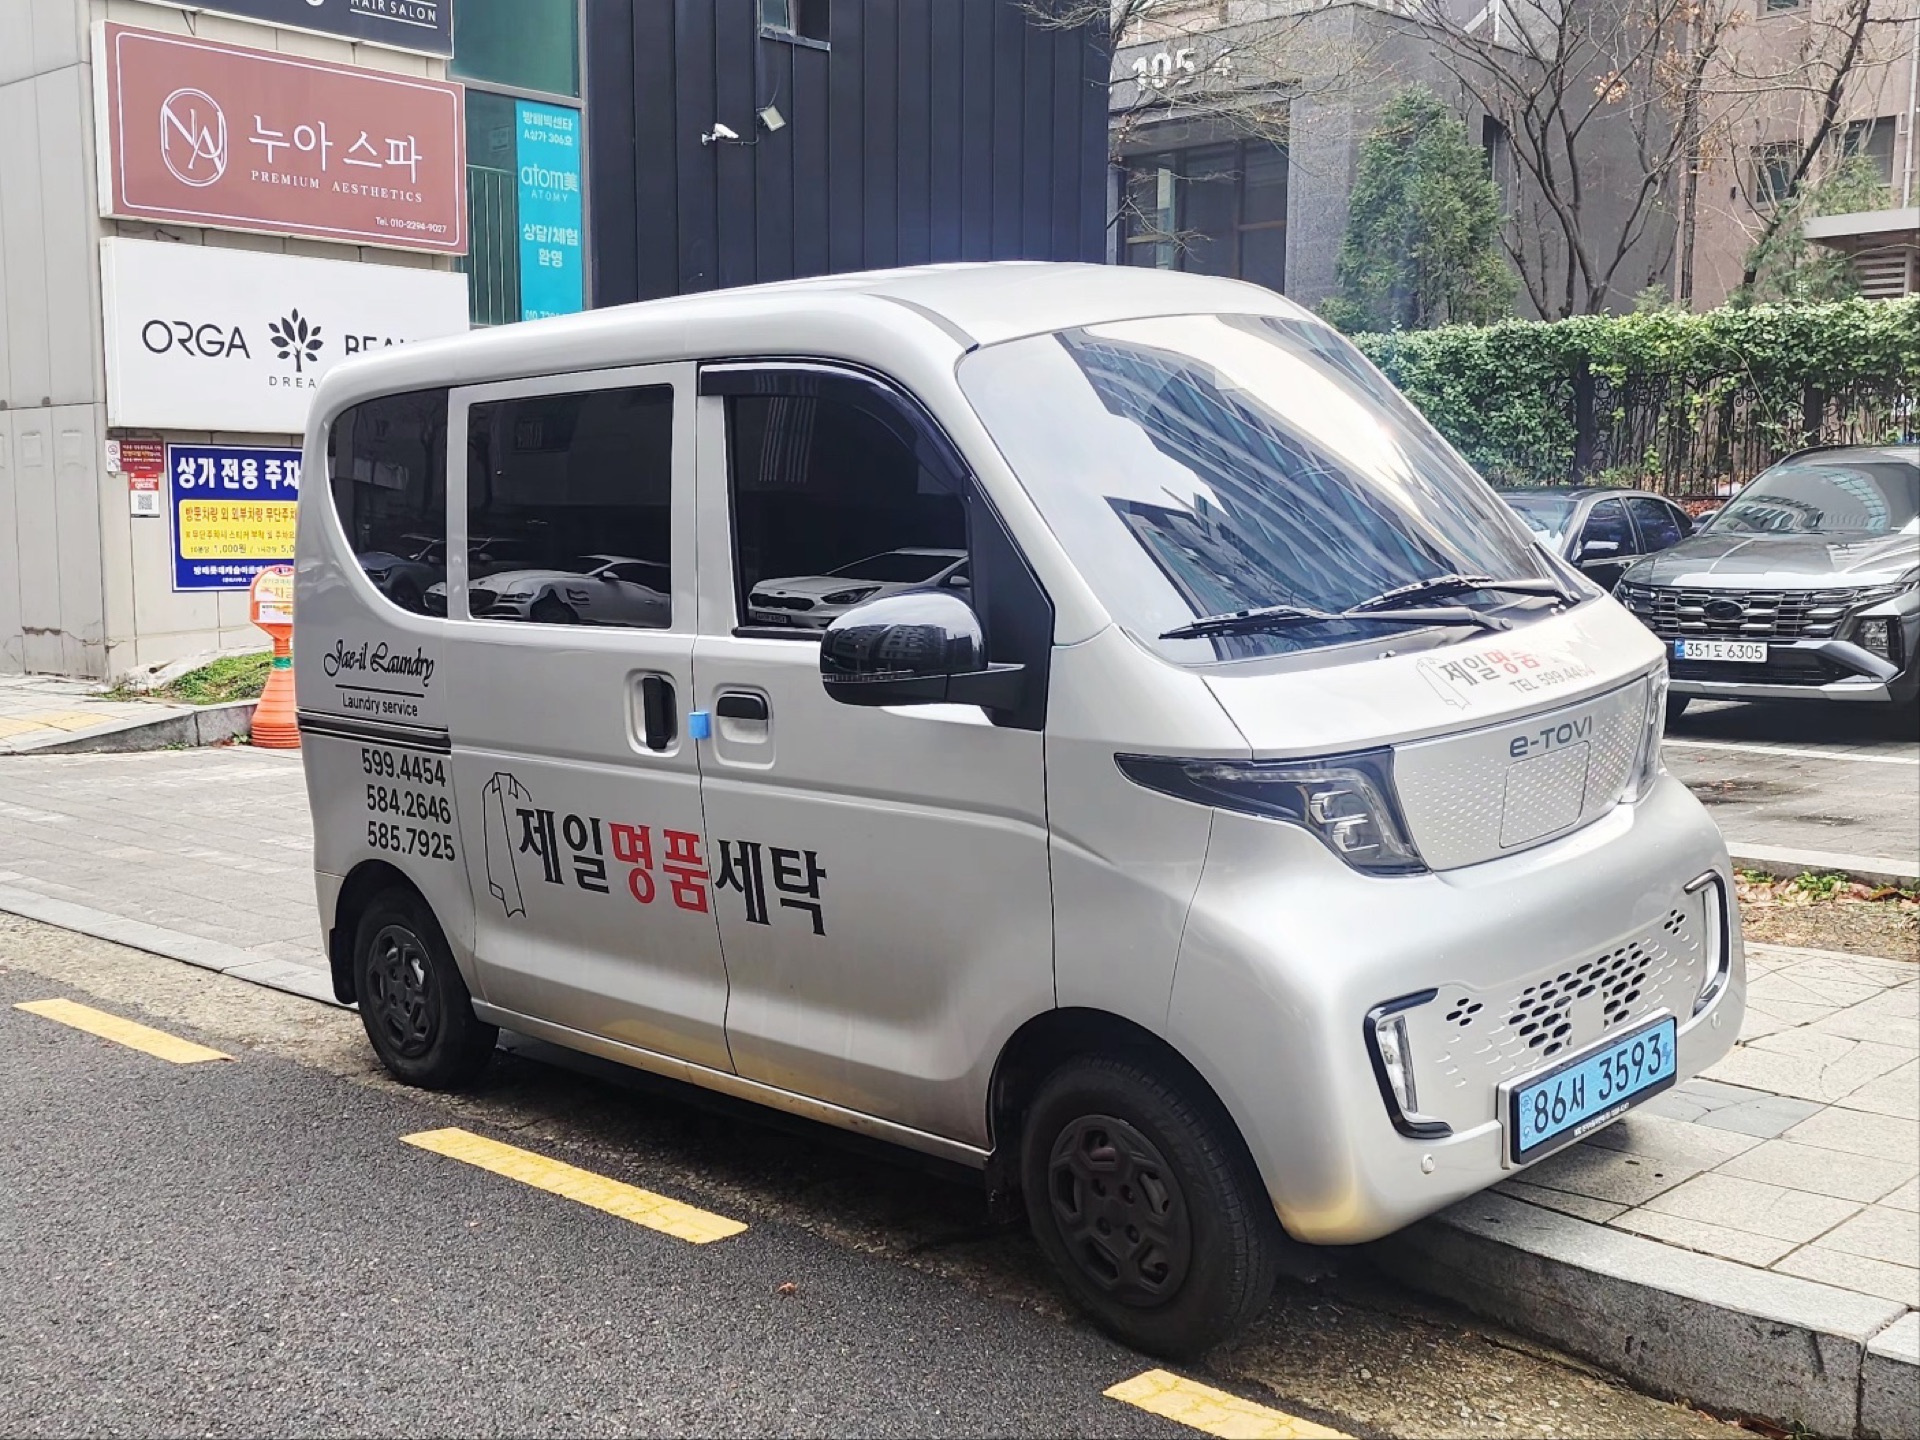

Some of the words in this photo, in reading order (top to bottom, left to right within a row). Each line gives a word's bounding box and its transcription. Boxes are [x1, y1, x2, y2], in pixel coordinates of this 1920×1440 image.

[390, 2, 436, 22] SALON
[249, 115, 333, 172] 누아
[343, 131, 423, 184] 스파
[251, 170, 320, 189] PREMIUM
[332, 181, 423, 203] AESTHETICS
[531, 189, 569, 203] ATOMY
[141, 319, 251, 359] ORGA
[268, 375, 317, 389] DREA
[177, 457, 216, 489] 상가
[220, 458, 259, 490] 전용
[264, 459, 300, 490] 주차
[323, 639, 369, 677] Jae-il
[370, 641, 434, 687] Laundry
[1685, 643, 1723, 658] 351도
[1726, 644, 1764, 660] 6305
[1508, 679, 1540, 694] TEL
[1540, 664, 1596, 687] 599.4454
[342, 692, 381, 715] Laundry
[382, 699, 418, 717] service
[1509, 715, 1593, 758] e-TOVI
[361, 748, 446, 787] 599.4454
[366, 784, 452, 825] 584.2646
[367, 820, 456, 862] 585.7925
[516, 808, 827, 937] 제일명품세탁
[1534, 1073, 1585, 1134] 86서
[1598, 1032, 1662, 1101] 3593
